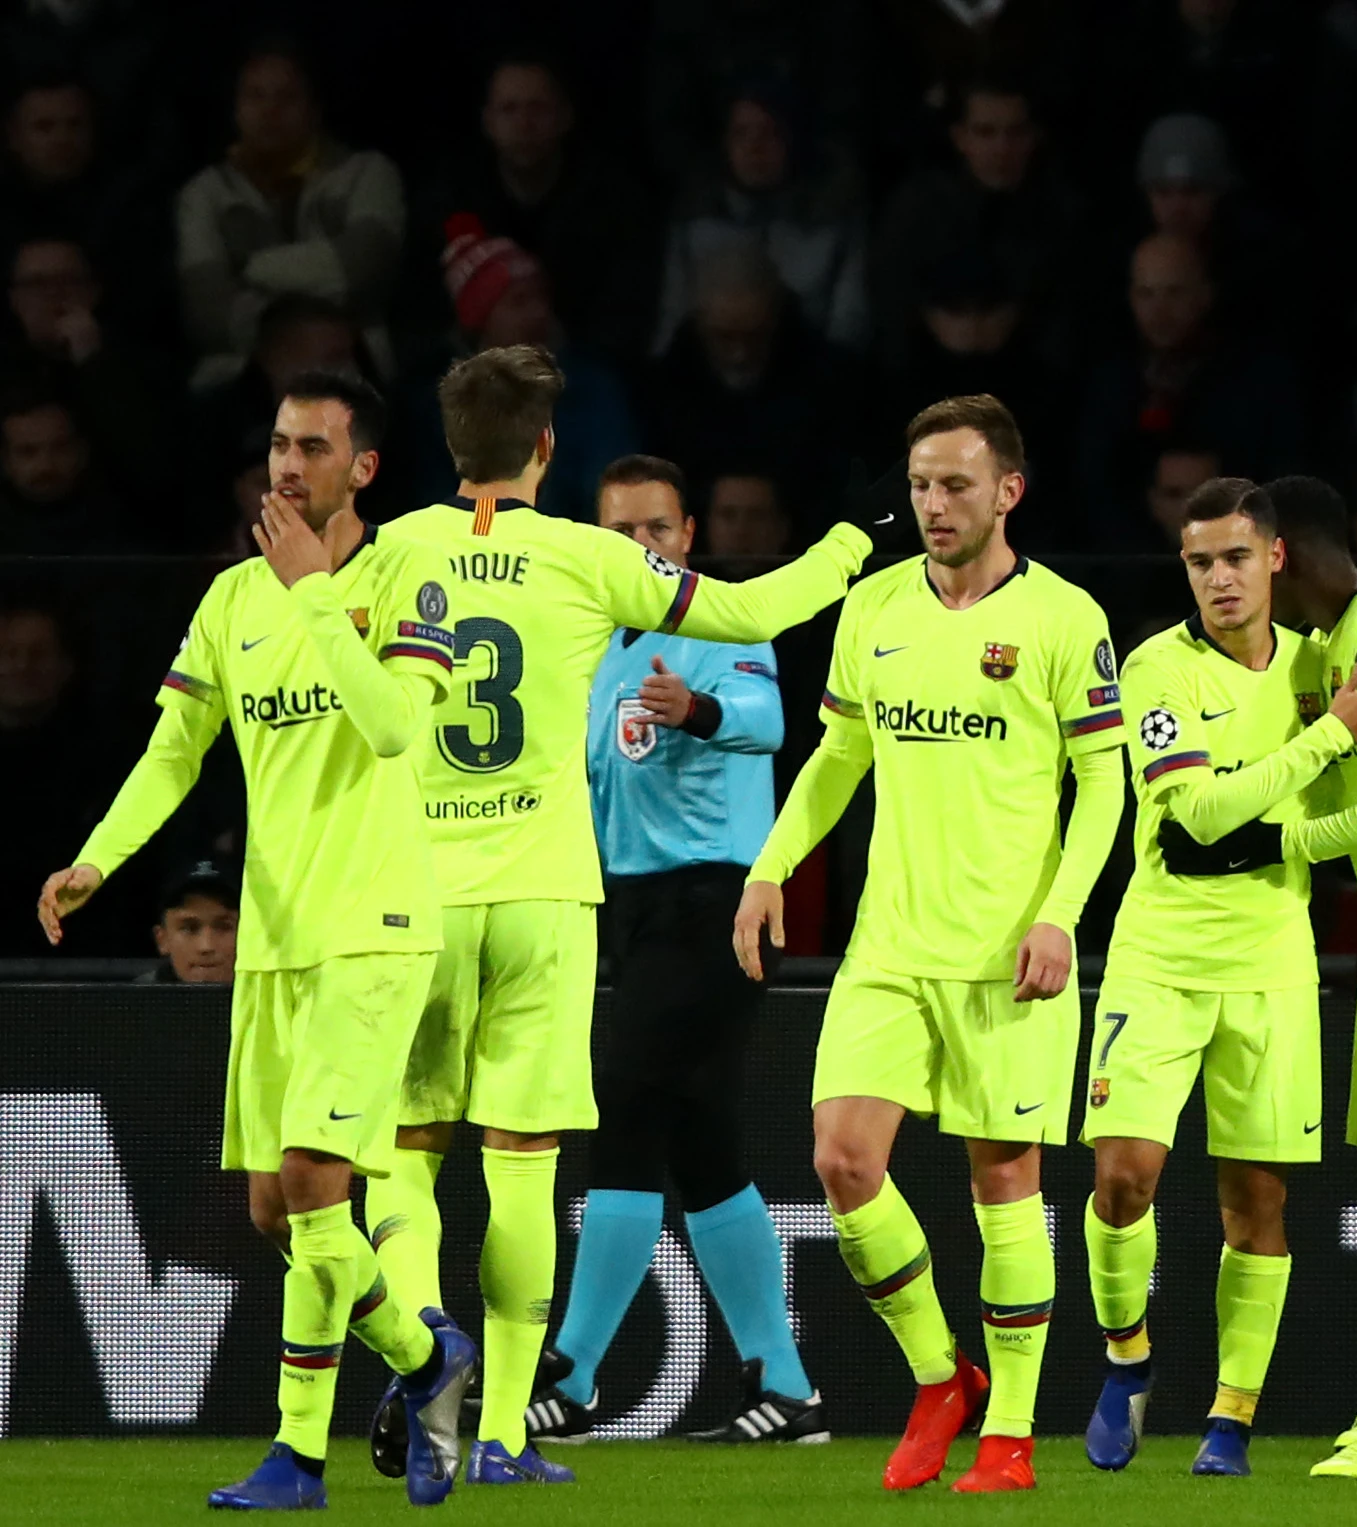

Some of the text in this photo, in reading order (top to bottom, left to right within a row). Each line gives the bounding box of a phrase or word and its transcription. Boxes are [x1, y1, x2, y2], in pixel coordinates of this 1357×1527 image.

[241, 682, 343, 723] Rakute
[435, 616, 524, 774] 3
[875, 700, 1007, 740] Rakuten
[426, 791, 508, 819] unicef
[1097, 1012, 1129, 1070] 7
